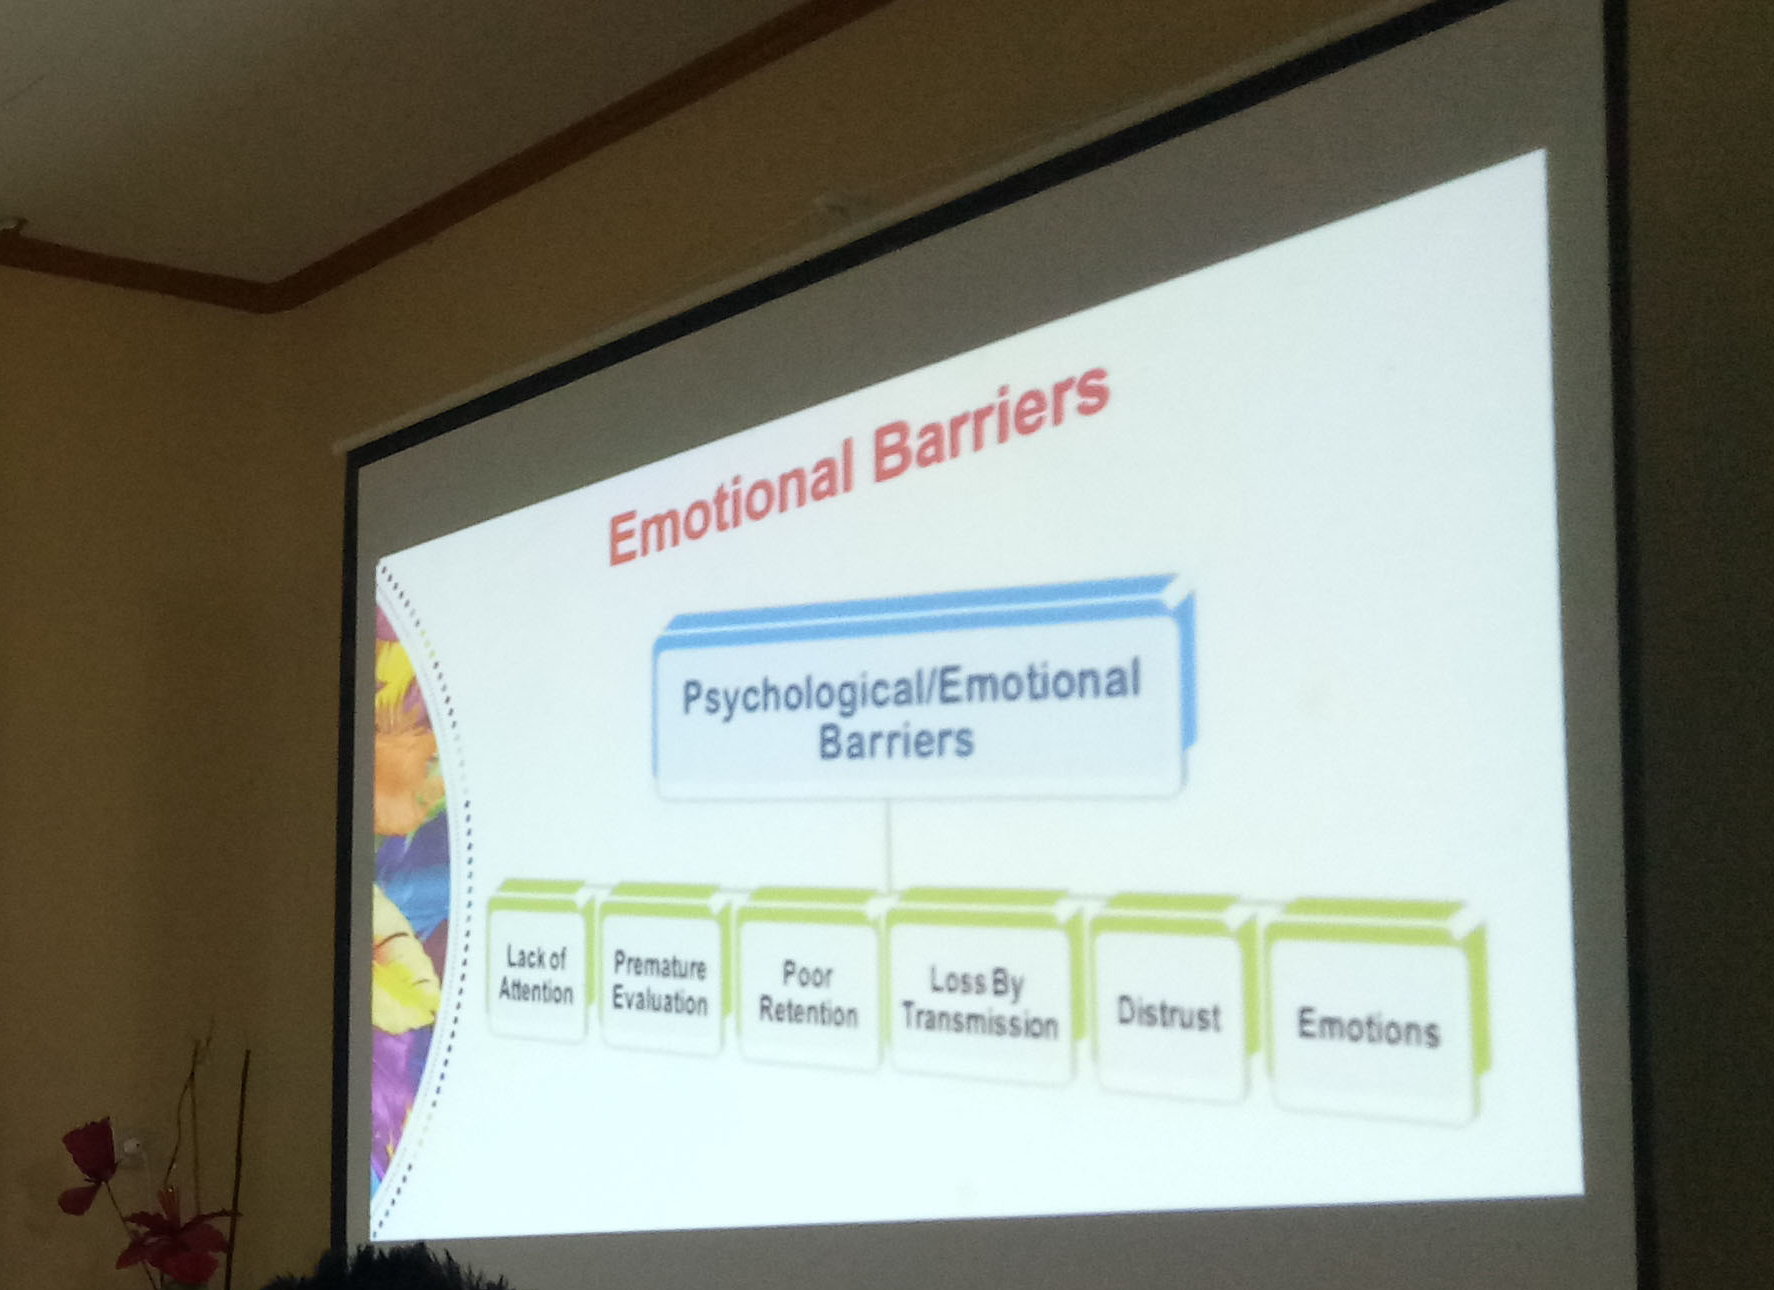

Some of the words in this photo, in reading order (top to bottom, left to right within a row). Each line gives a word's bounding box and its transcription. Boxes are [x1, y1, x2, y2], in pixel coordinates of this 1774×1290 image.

[608, 437, 855, 566] Emotional
[873, 366, 1112, 483] Barriers
[682, 656, 1142, 723] Psychological/Emotional
[818, 722, 976, 762] Barriers
[506, 943, 545, 970] Lack
[549, 945, 568, 971] of
[613, 948, 708, 981] Premature
[782, 958, 834, 989] Poor
[498, 976, 575, 1006] Attention
[611, 983, 709, 1017] Evaluation
[930, 964, 987, 996] Loss
[992, 965, 1025, 1005] By
[759, 993, 859, 1029] Retention
[901, 999, 1060, 1041] Transmission
[1117, 993, 1223, 1034] Distrust
[1296, 1005, 1443, 1050] Emotions
